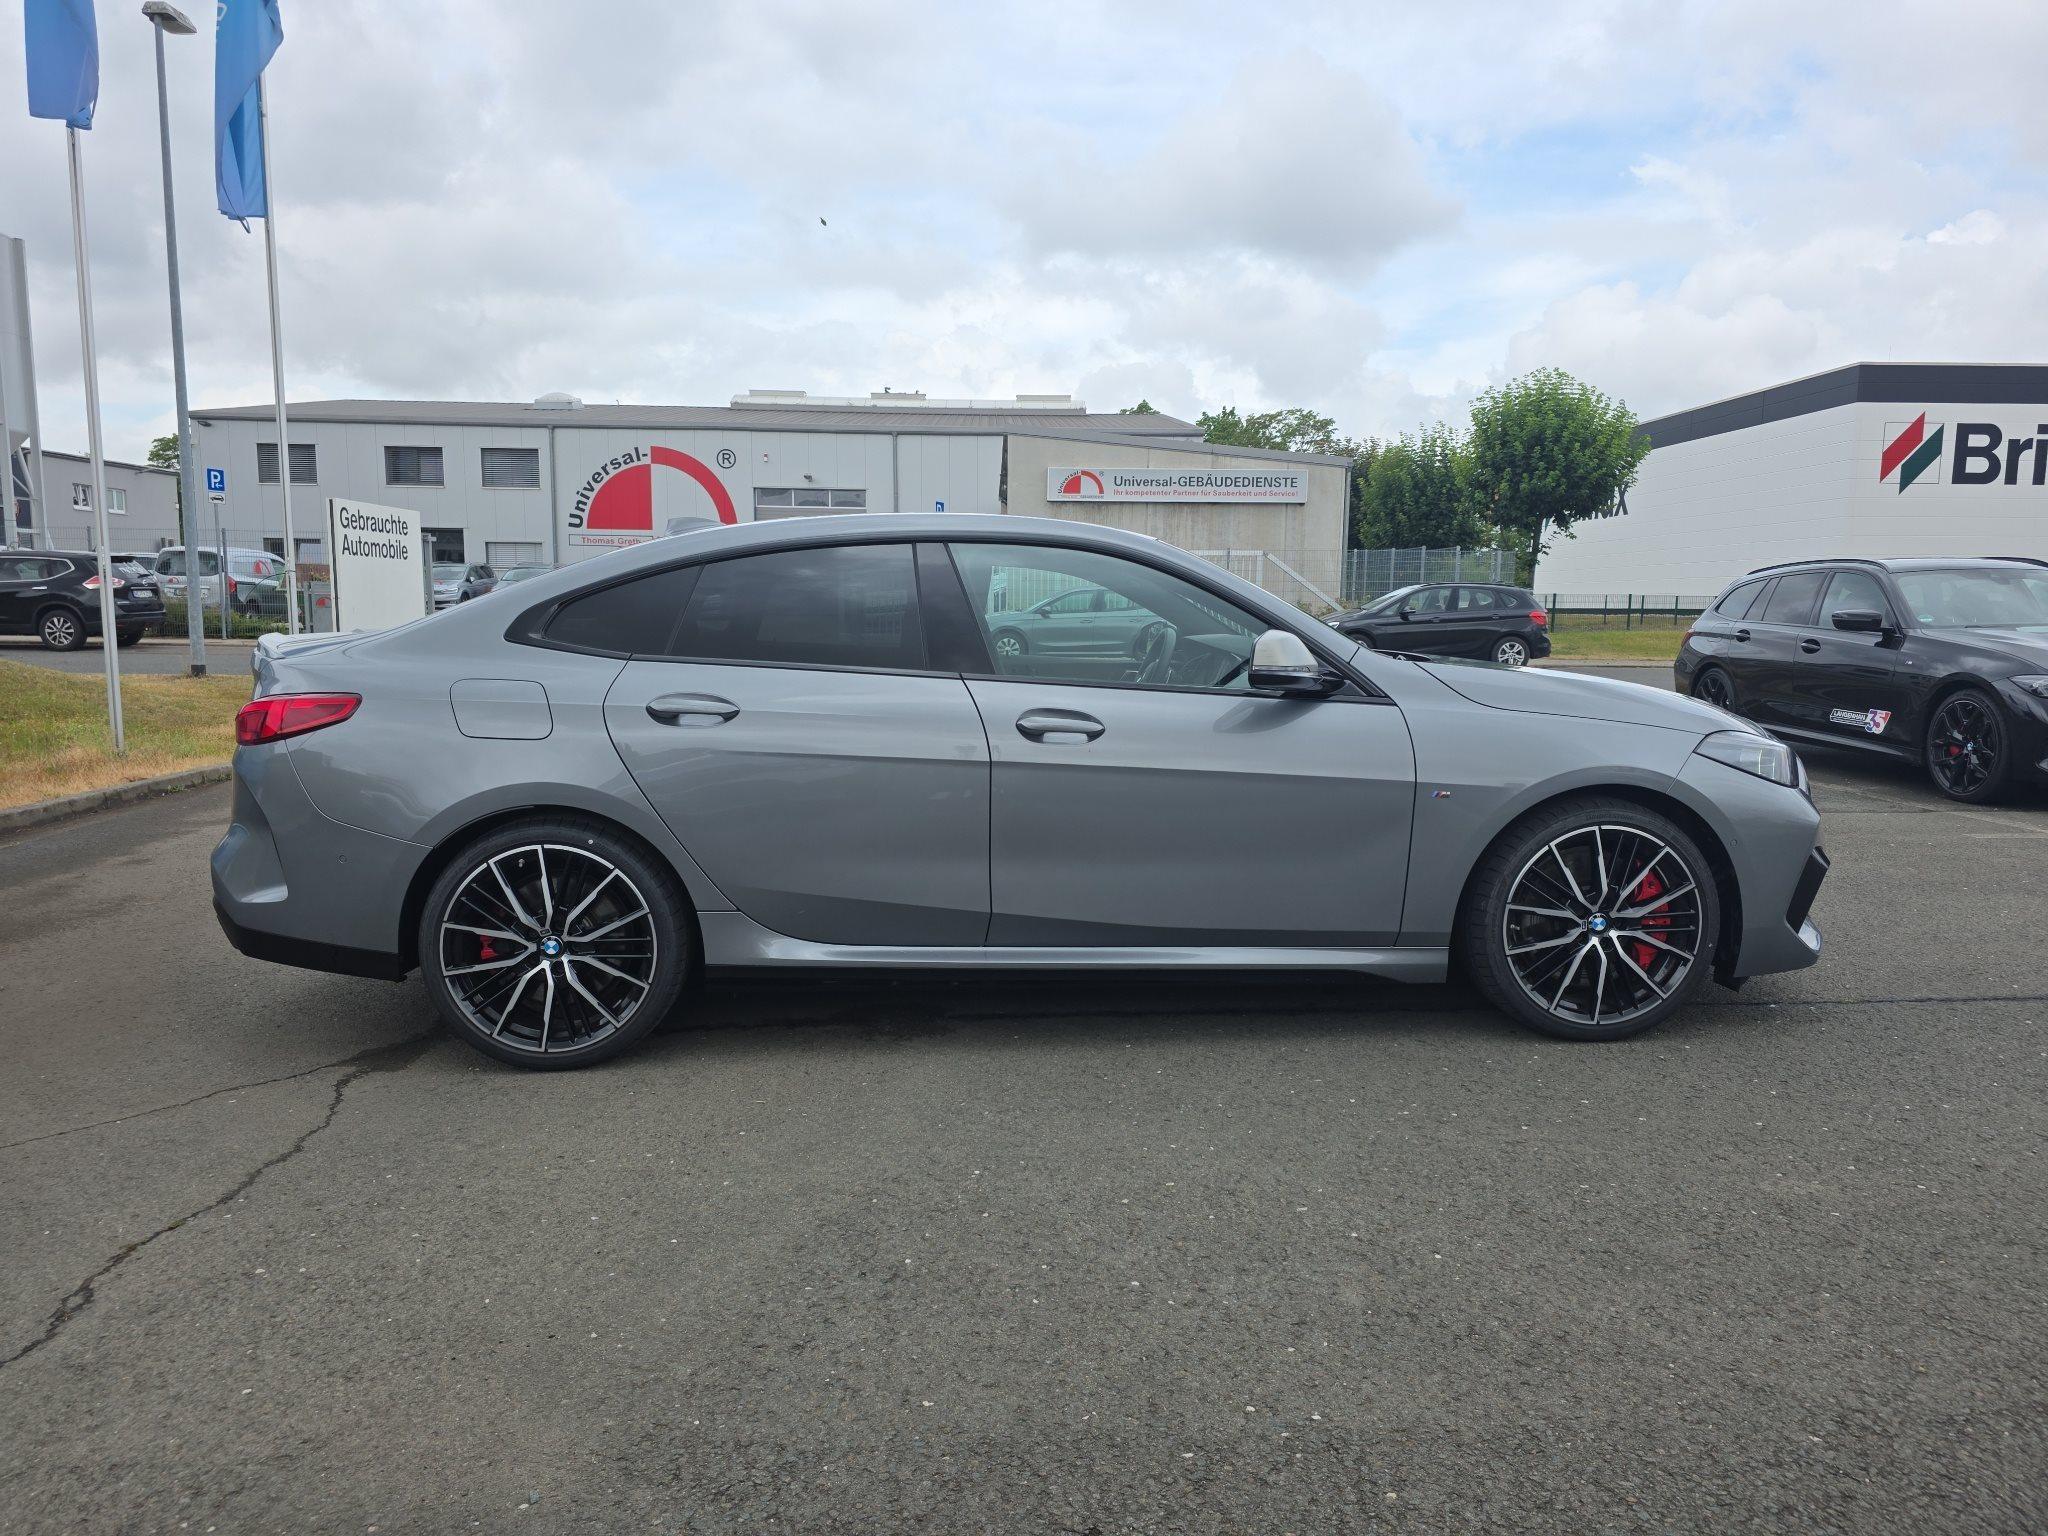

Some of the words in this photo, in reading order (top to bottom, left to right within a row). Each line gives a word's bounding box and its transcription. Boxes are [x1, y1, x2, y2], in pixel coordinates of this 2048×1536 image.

[1951, 422, 2048, 486] Bri
[210, 470, 221, 489] P
[568, 446, 648, 529] Universal-
[1113, 474, 1298, 488] Universal-GEBÄUDEDIENSTE
[1125, 489, 1171, 497] kompetenter
[1201, 489, 1211, 497] für
[1212, 489, 1252, 497] Sauberkeit
[340, 506, 409, 536] Gebrauchte
[342, 533, 409, 560] Automobile
[581, 536, 615, 545] Thomas
